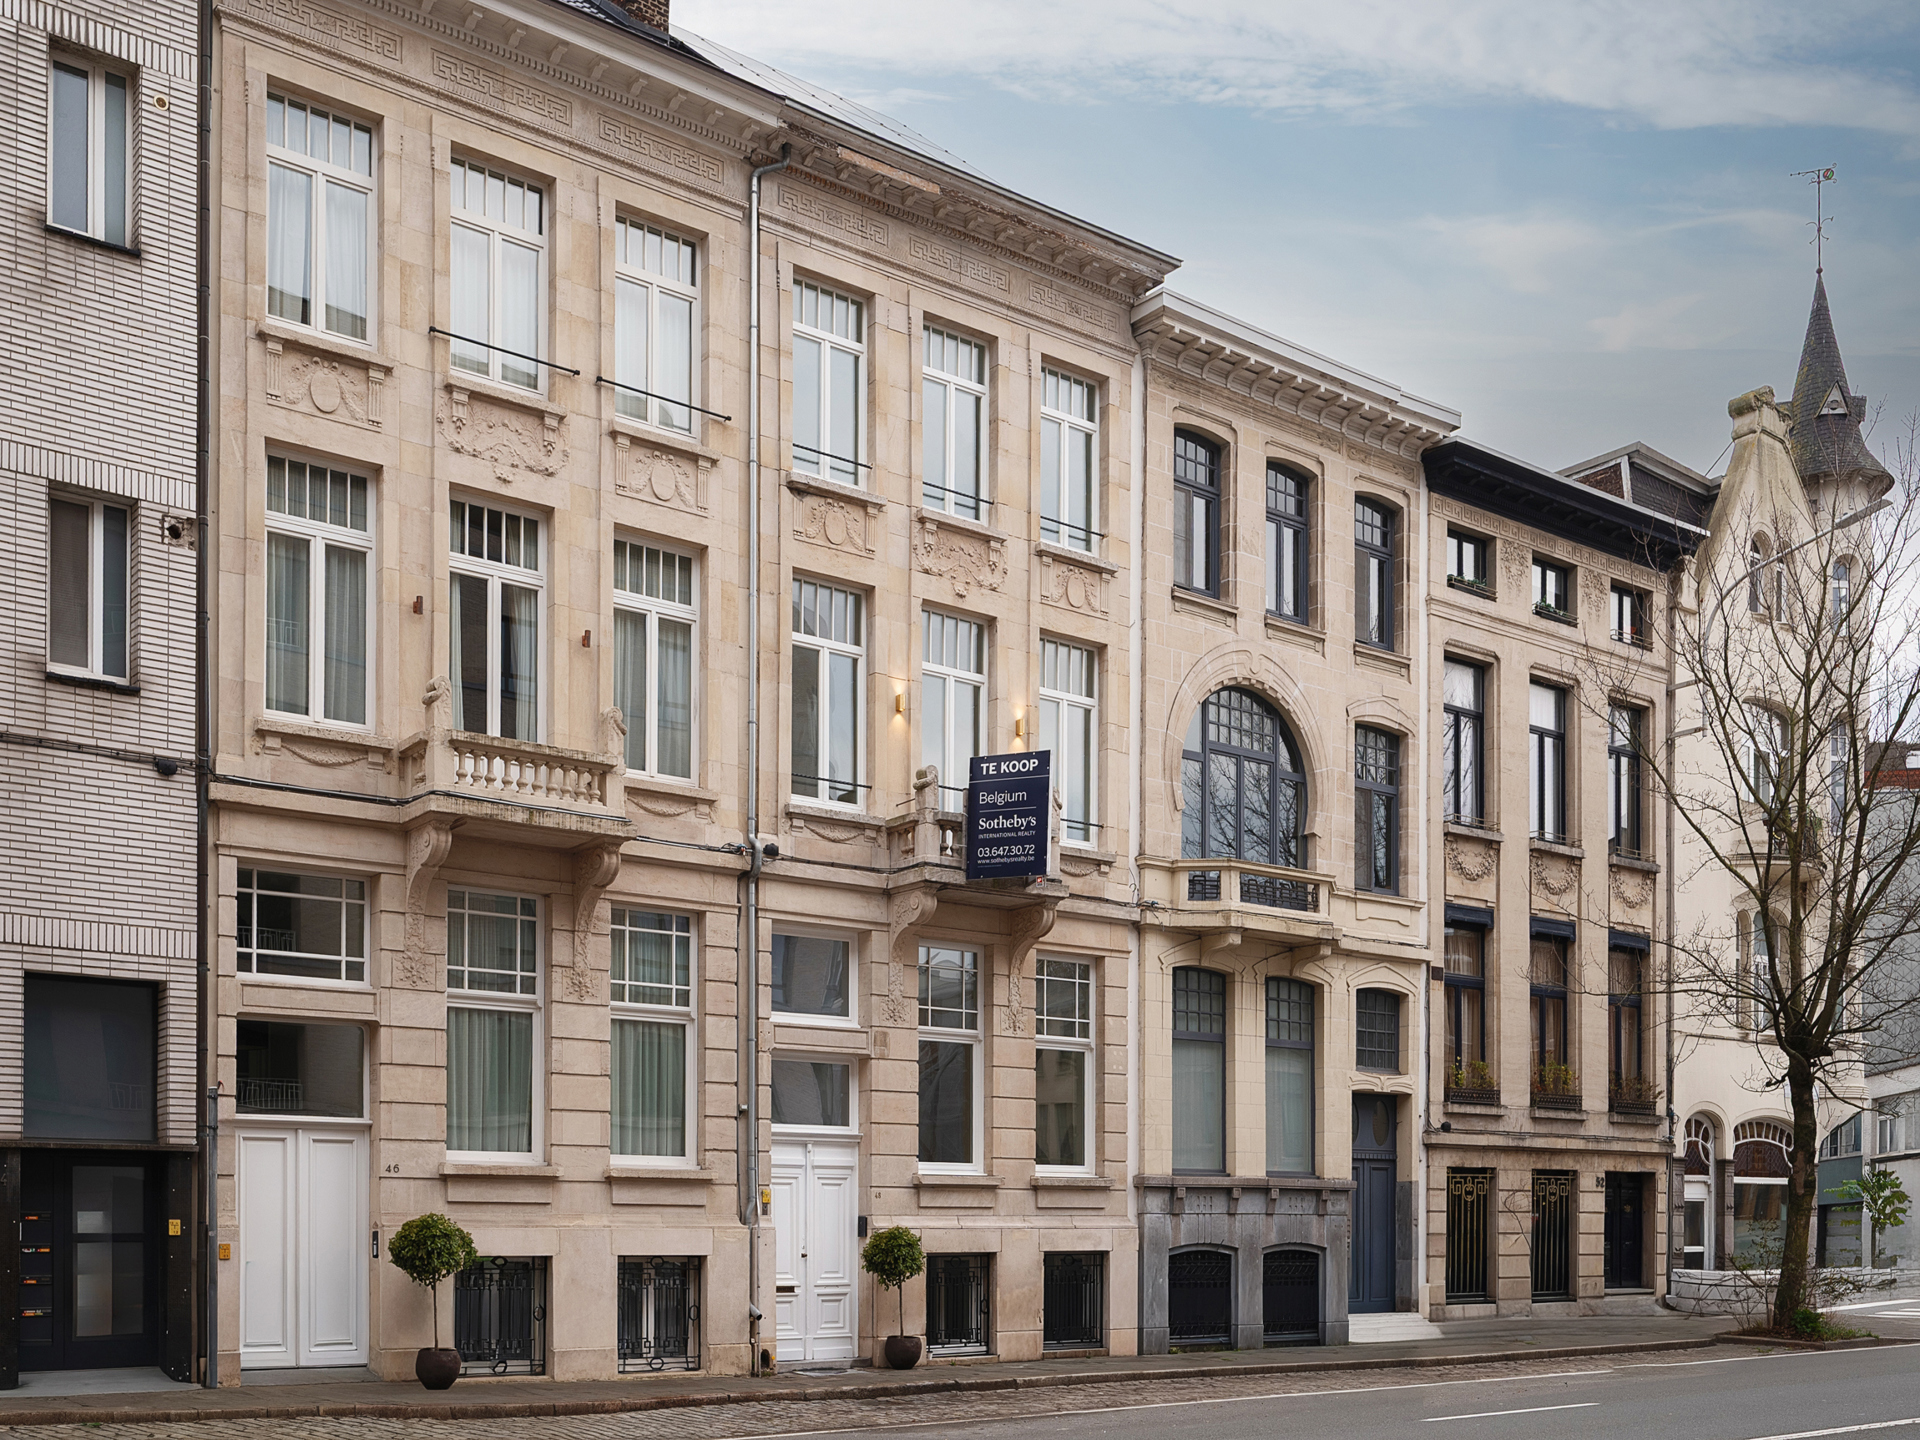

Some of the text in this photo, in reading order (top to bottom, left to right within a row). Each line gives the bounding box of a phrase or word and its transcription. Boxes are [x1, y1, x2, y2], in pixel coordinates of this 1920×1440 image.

[981, 759, 1039, 775] TE KOOP
[979, 791, 1027, 805] Belgium
[978, 814, 1037, 830] Sotheby's
[978, 831, 1017, 839] INTERNATIONAL
[977, 844, 1035, 857] 03.647.30.72
[977, 855, 1035, 864] www.sothebysrealty.be
[385, 1164, 400, 1173] 46
[1595, 1176, 1605, 1188] 52
